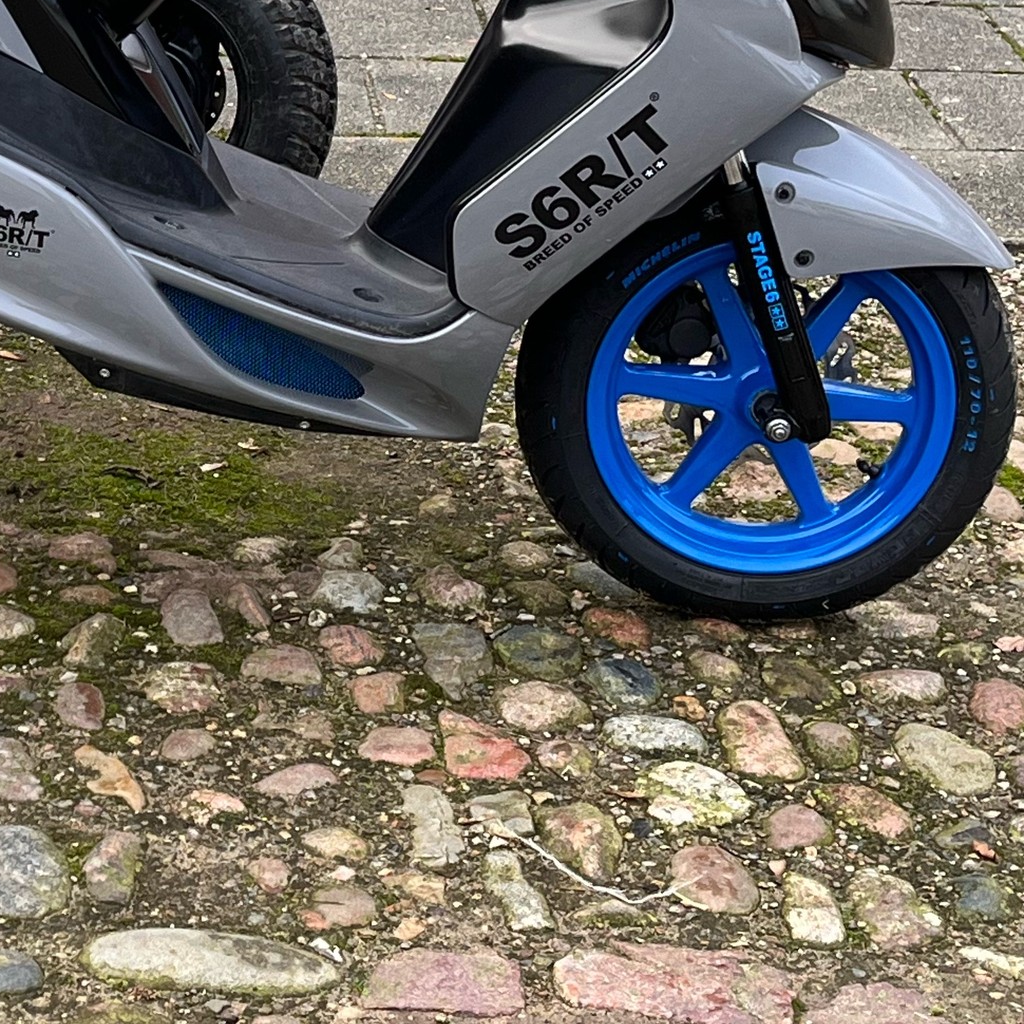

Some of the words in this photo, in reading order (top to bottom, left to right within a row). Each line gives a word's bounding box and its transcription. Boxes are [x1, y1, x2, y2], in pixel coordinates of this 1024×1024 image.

[523, 232, 573, 272] BREED
[573, 215, 593, 234] OF
[594, 177, 644, 217] SPEED
[621, 231, 701, 289] MICHELIN
[747, 231, 780, 303] STAGE6
